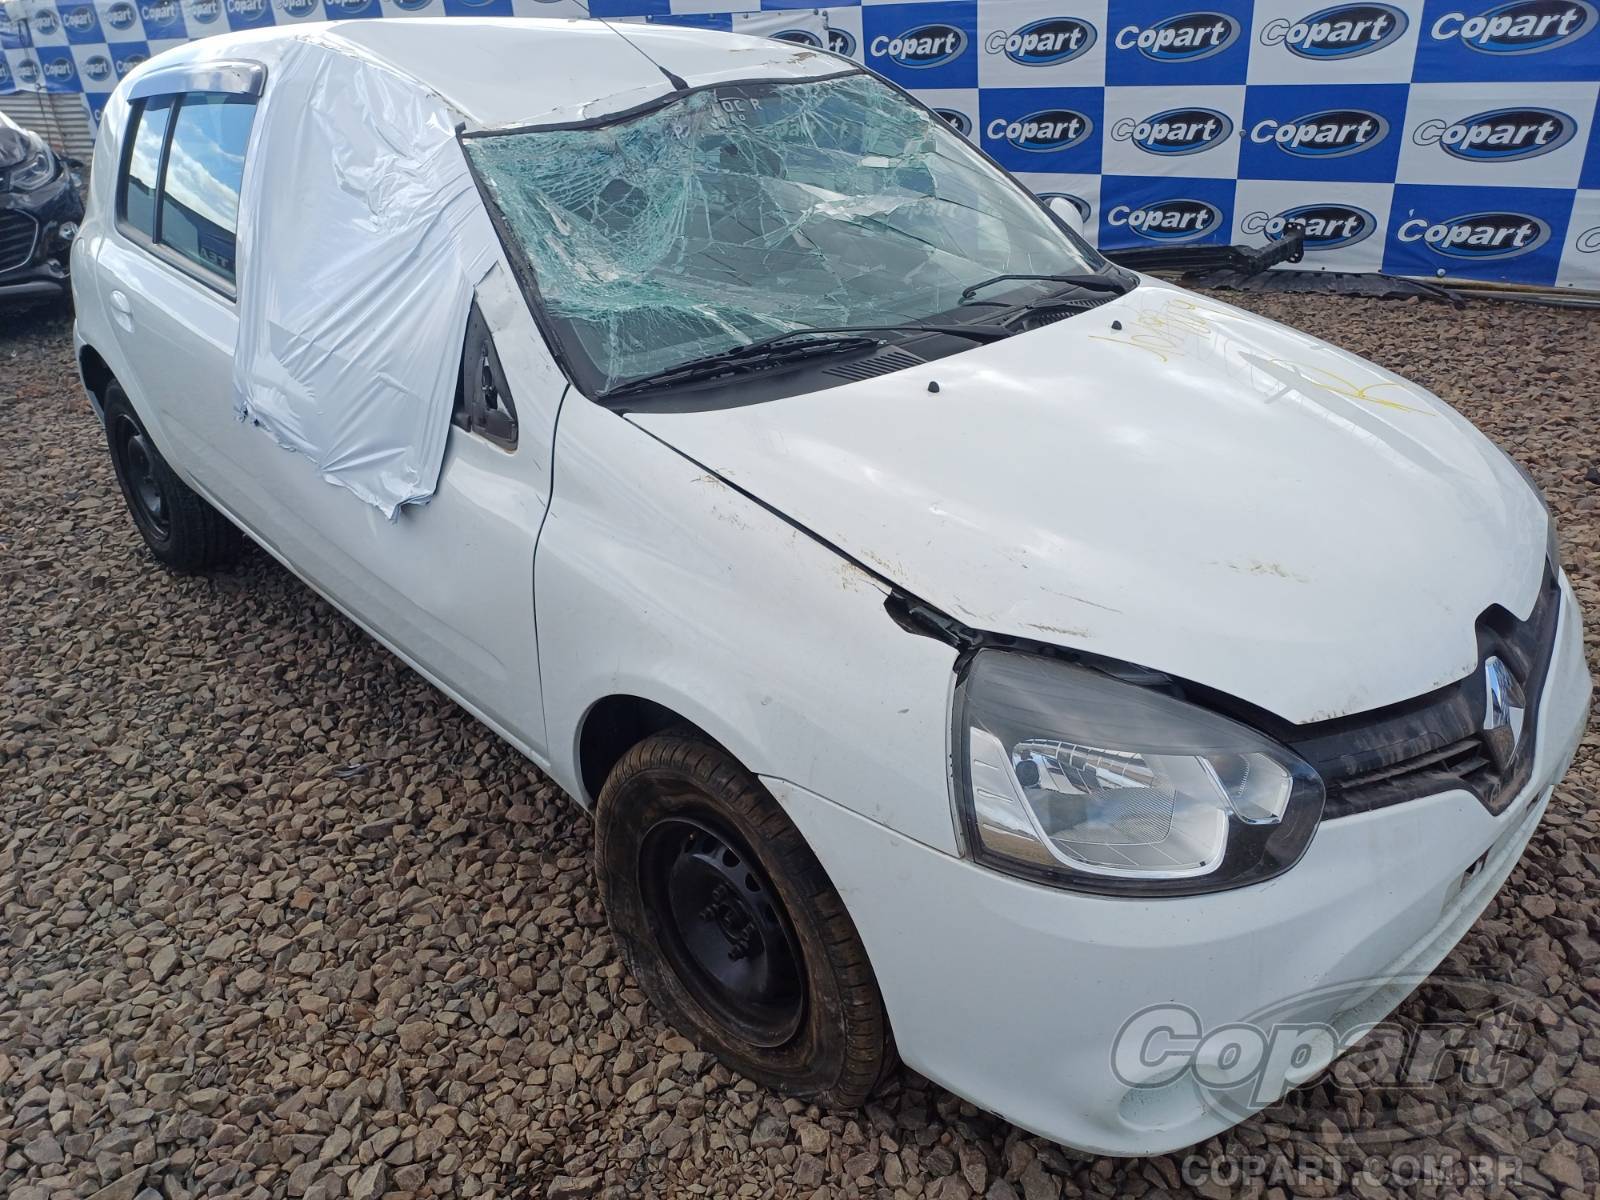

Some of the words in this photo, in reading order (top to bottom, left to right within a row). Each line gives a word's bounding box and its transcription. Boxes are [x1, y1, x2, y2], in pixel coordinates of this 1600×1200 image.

[141, 5, 176, 21] Copart
[1431, 4, 1580, 44] Copart
[870, 32, 956, 60] Copart
[985, 27, 1082, 58] Copart
[1115, 21, 1224, 52] Copart
[1259, 12, 1389, 50] Copart
[986, 113, 1080, 140] Copart
[1111, 116, 1217, 143] Copart
[1250, 116, 1372, 148] Copart
[1413, 116, 1556, 151] Copart
[1107, 205, 1210, 234] Copart
[1397, 219, 1532, 248] Copart
